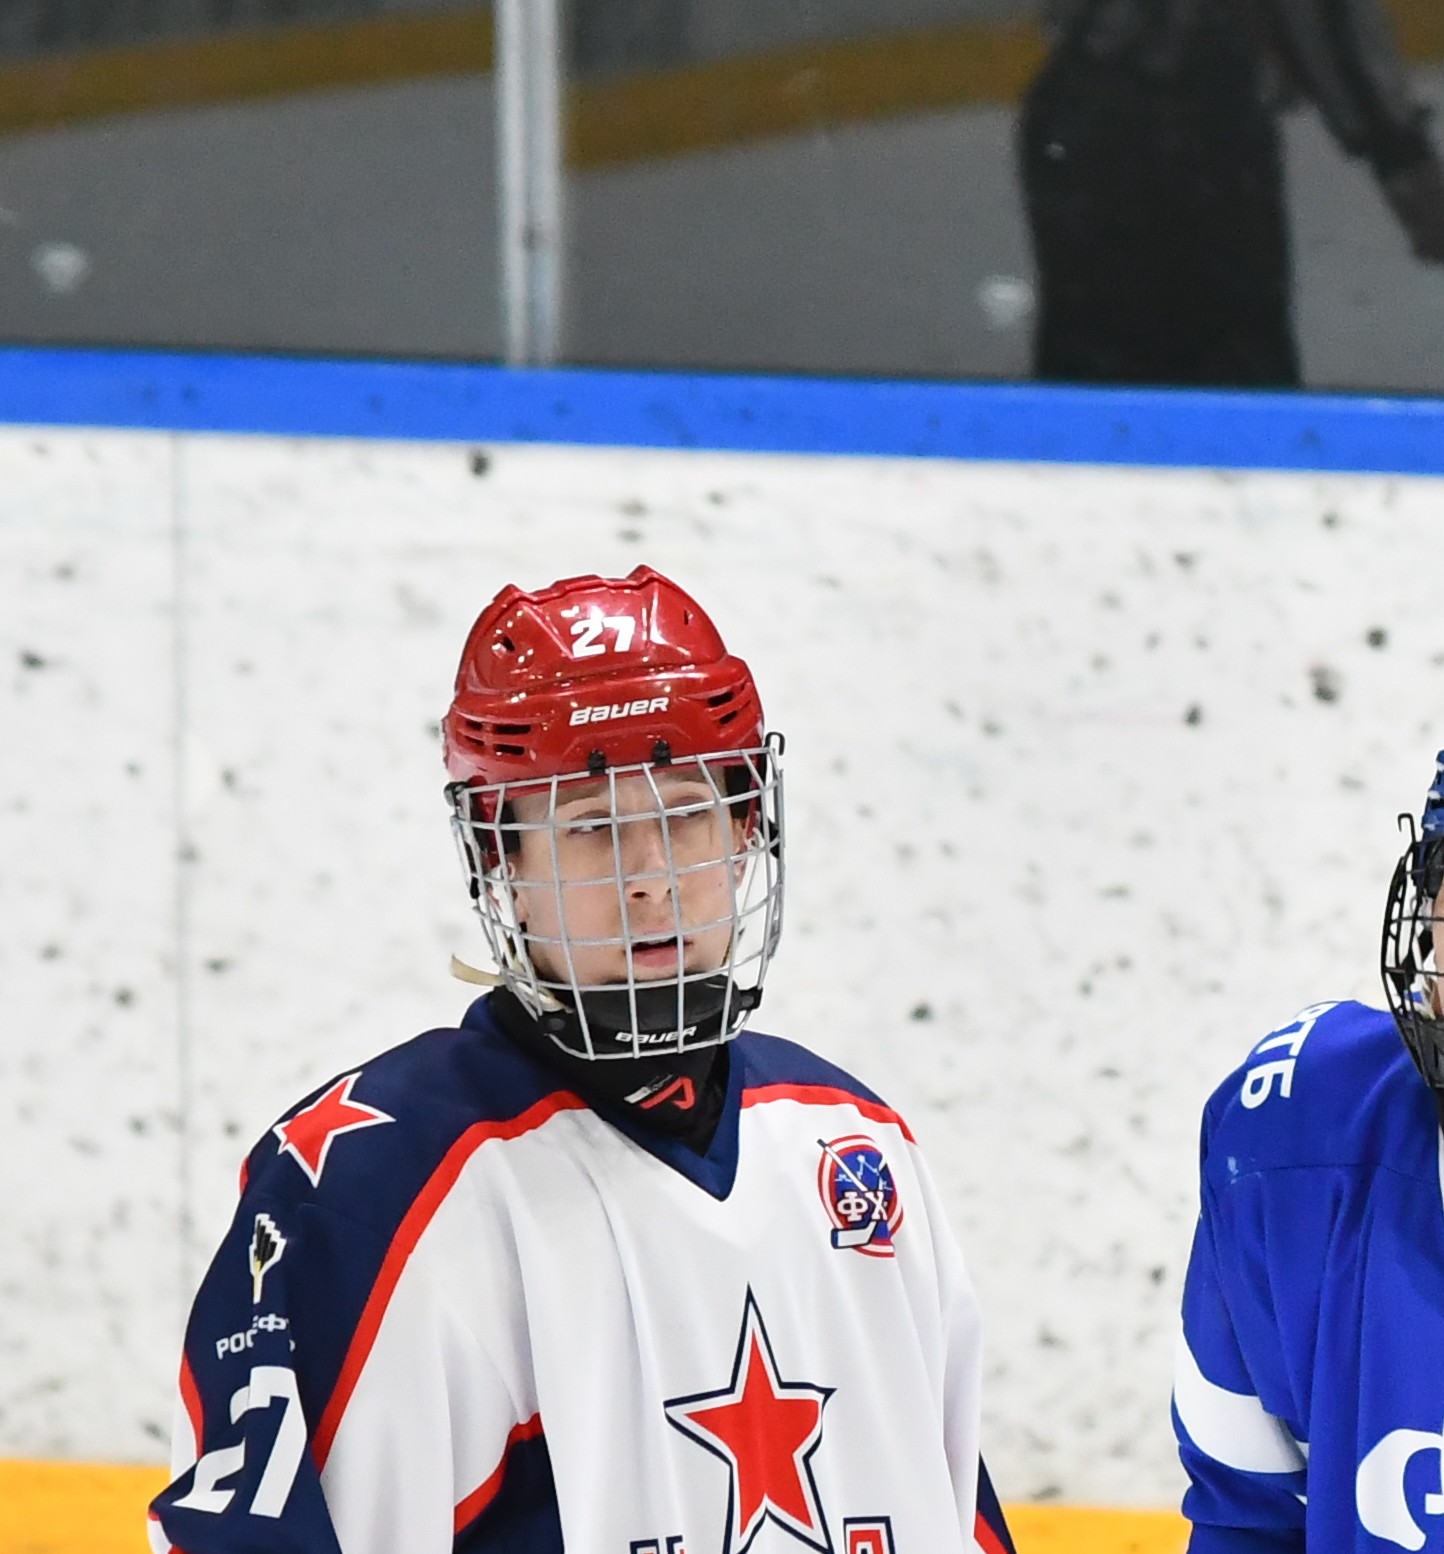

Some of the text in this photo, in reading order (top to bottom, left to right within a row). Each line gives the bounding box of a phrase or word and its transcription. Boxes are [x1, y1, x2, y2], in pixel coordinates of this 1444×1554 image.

[570, 615, 636, 658] 27
[568, 697, 669, 727] BAUER
[837, 1190, 889, 1222] ФХ
[171, 1366, 308, 1519] 27
